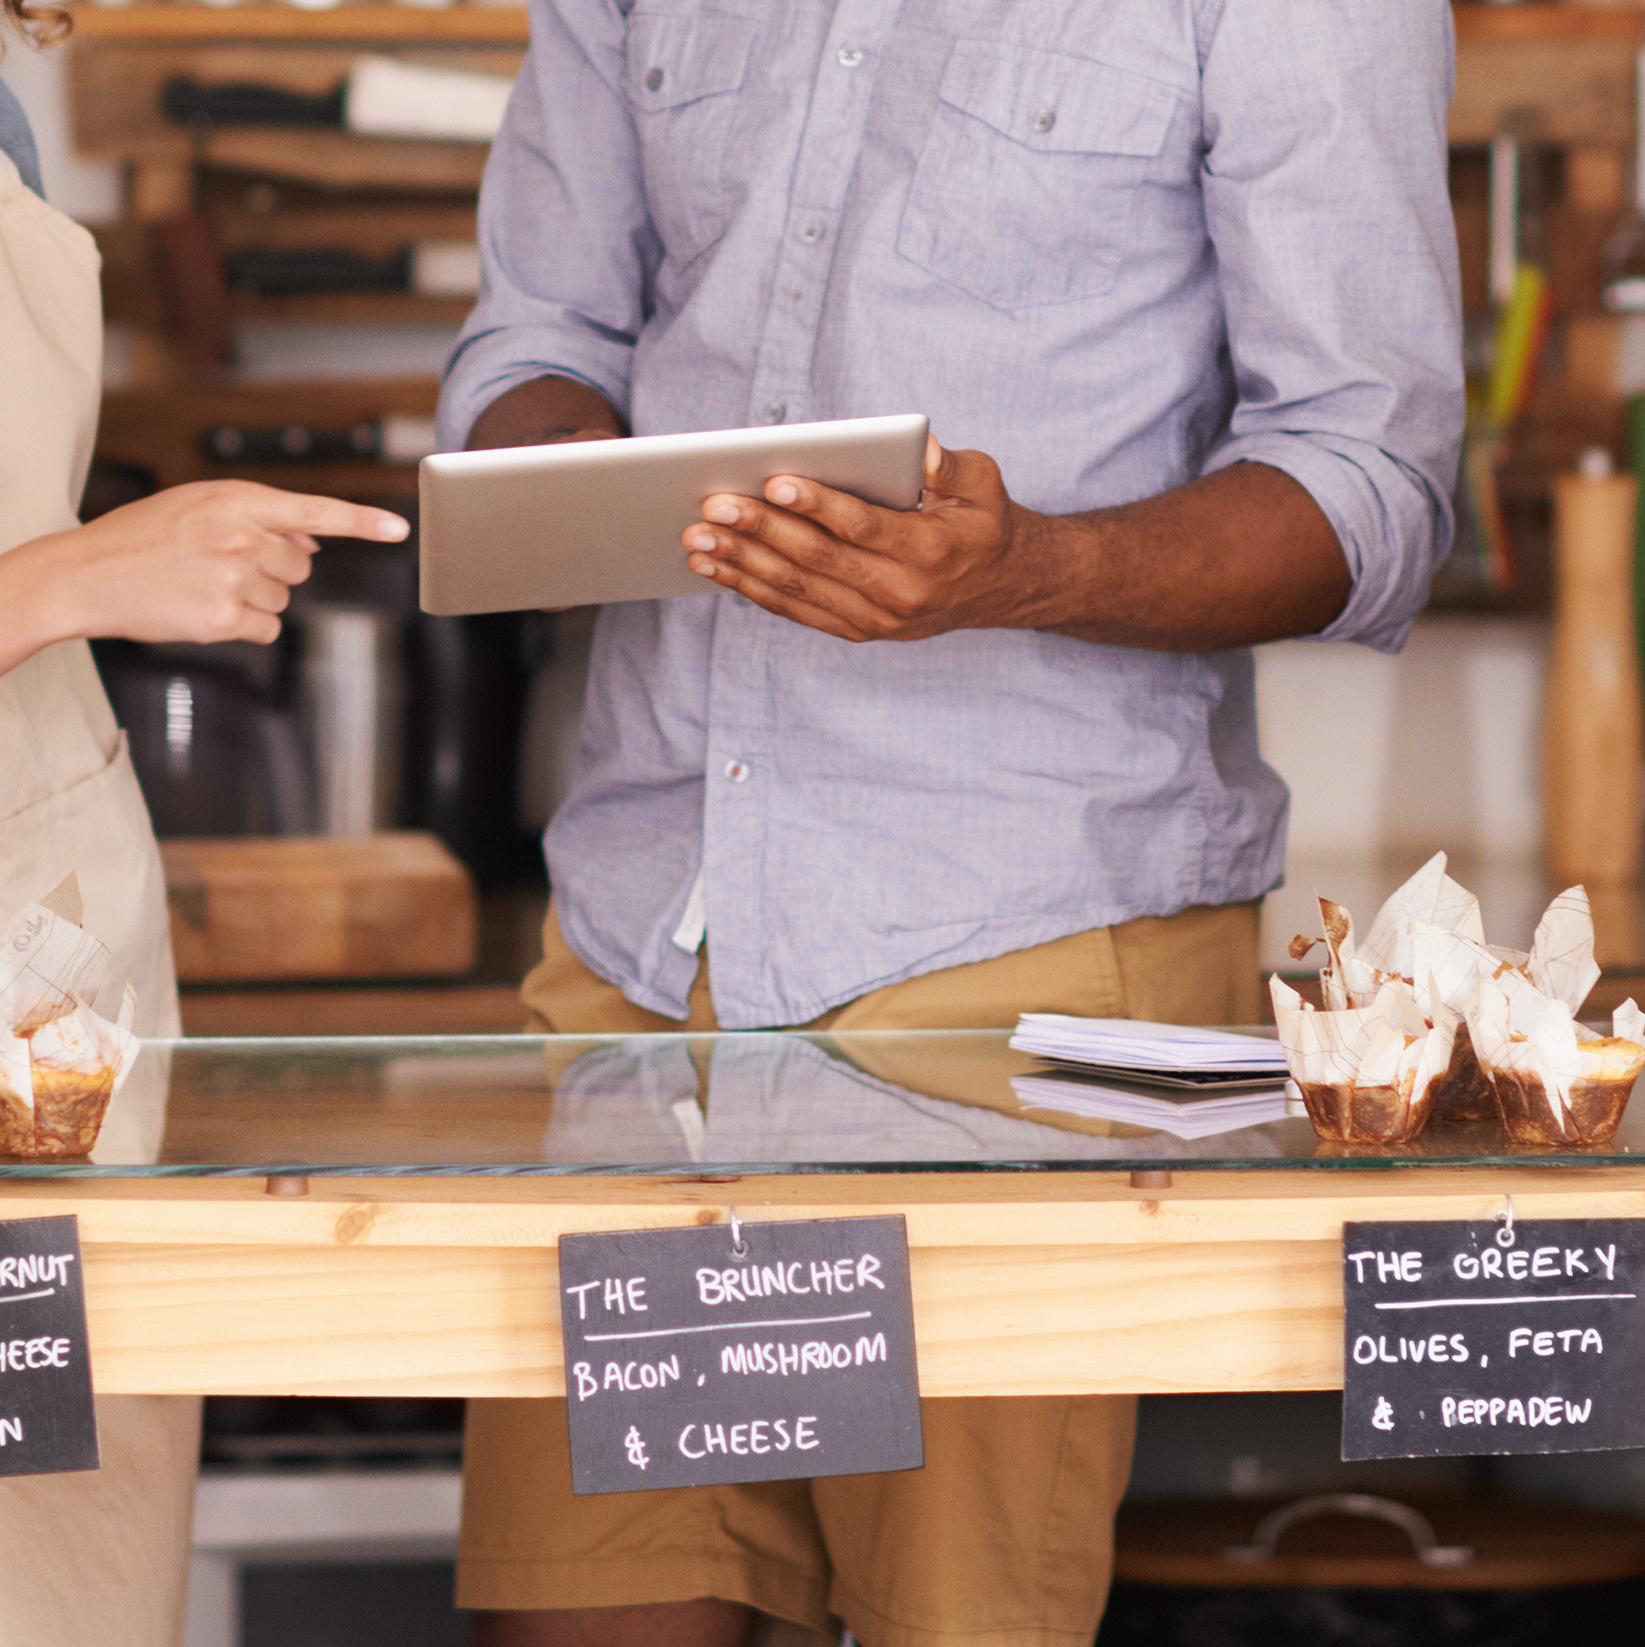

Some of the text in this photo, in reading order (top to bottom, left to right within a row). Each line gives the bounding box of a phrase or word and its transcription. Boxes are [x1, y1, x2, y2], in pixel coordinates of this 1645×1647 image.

[1348, 1244, 1615, 1283] THE GREEKY
[567, 1253, 885, 1319] THE BRUNCHER
[721, 1333, 886, 1375] MUSHROOM
[1354, 1328, 1602, 1367] OLIVES, FETA
[1372, 1396, 1591, 1430] & PEPPADEW
[625, 1417, 819, 1470] & CHEESE
